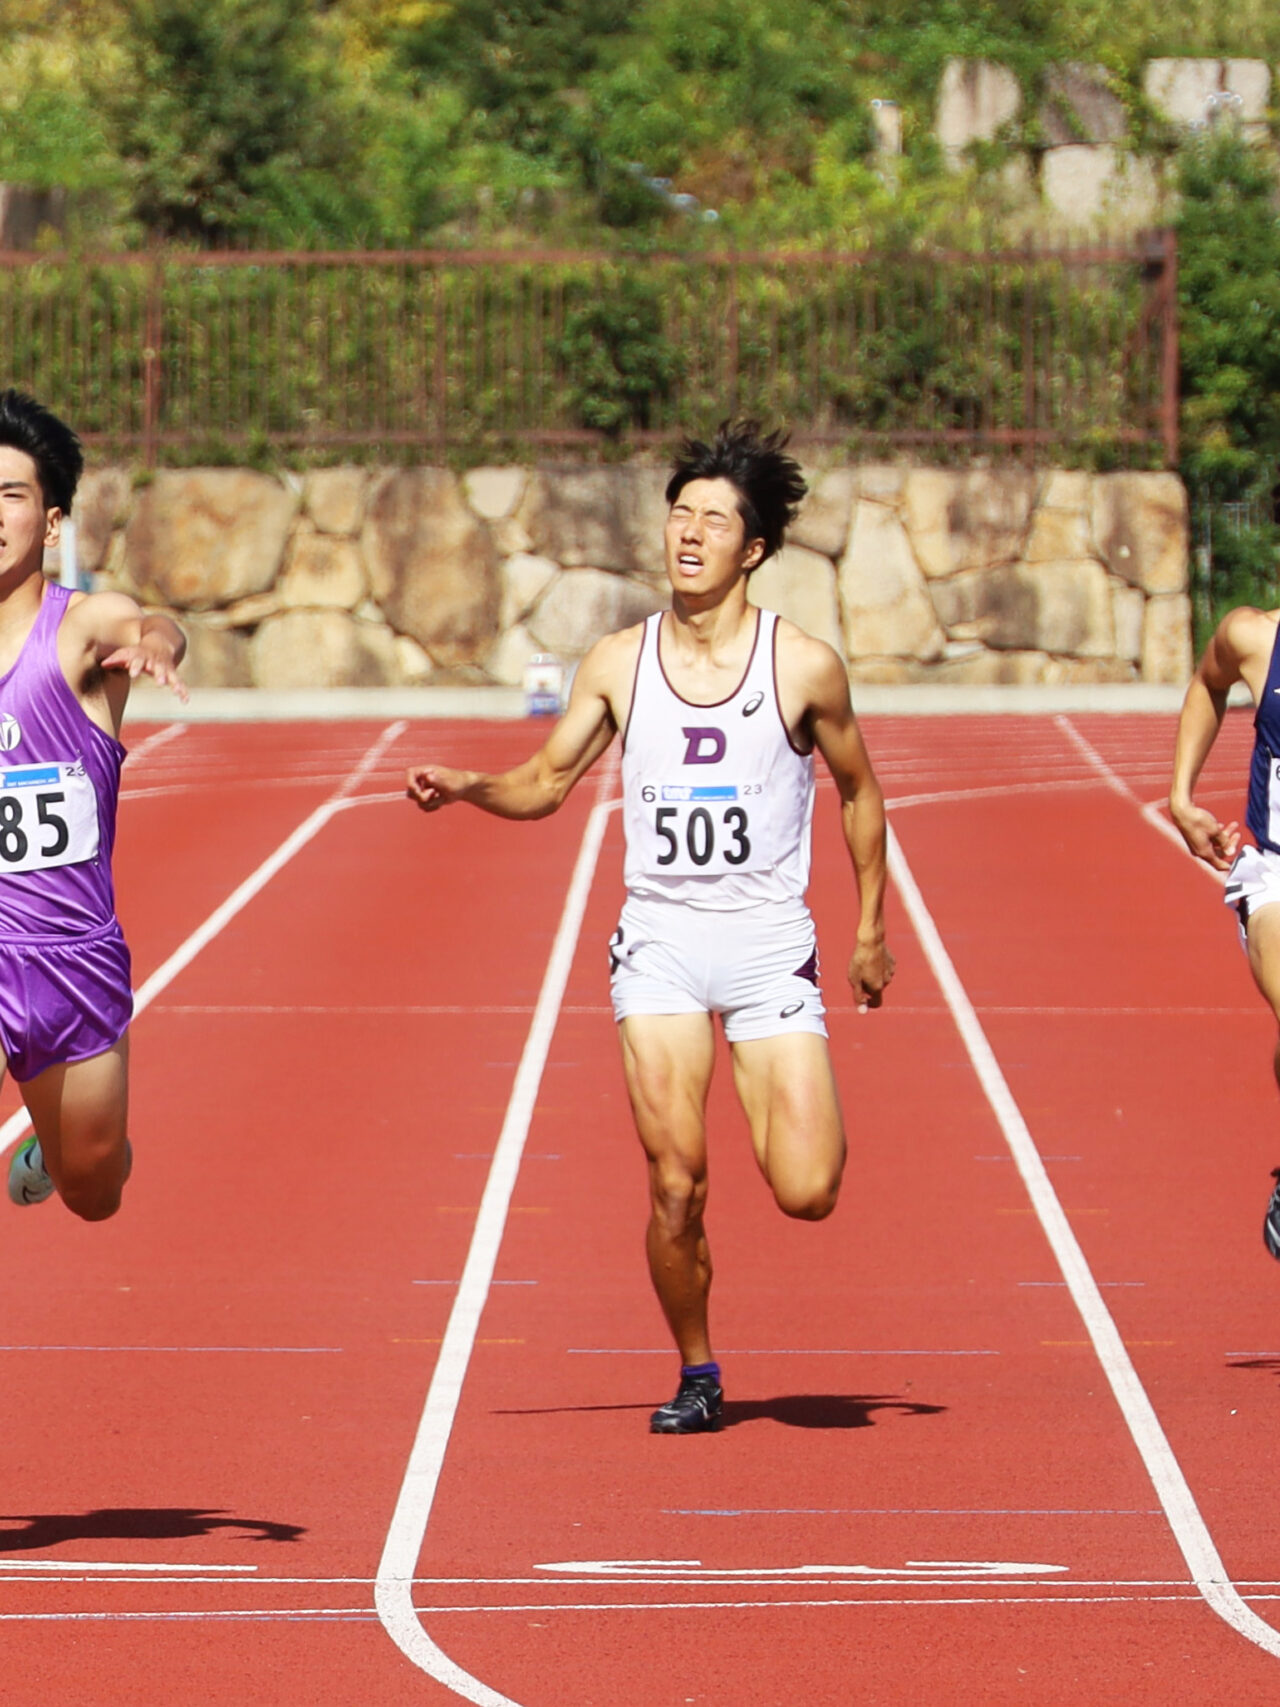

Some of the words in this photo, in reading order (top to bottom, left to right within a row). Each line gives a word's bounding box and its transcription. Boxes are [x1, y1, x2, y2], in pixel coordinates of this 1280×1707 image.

[681, 726, 727, 765] D
[65, 766, 86, 777] 23
[641, 785, 656, 803] 6
[743, 784, 763, 796] 23
[655, 806, 752, 866] 503
